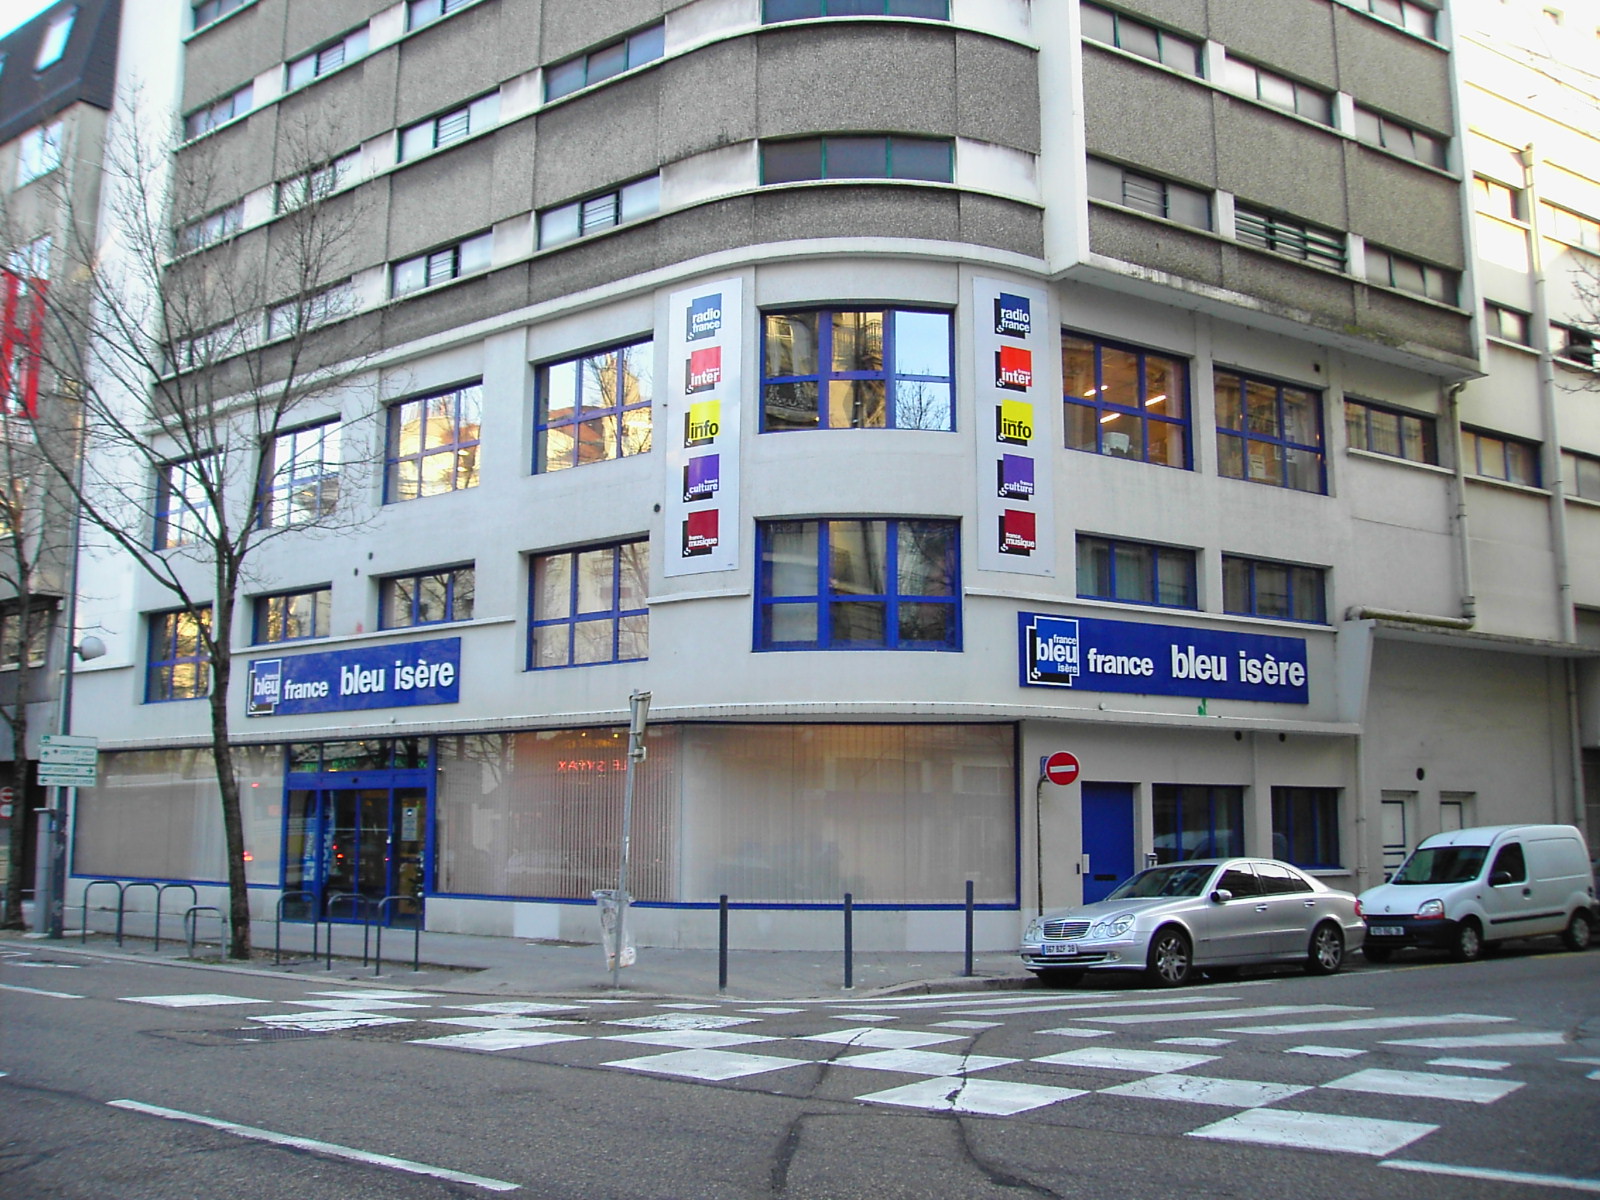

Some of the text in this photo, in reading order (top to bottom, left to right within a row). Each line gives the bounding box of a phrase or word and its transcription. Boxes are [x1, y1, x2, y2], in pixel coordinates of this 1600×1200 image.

[692, 308, 721, 323] radio
[1001, 308, 1030, 323] radio
[692, 320, 721, 333] france
[1001, 318, 1030, 332] france
[690, 371, 720, 387] inter
[1001, 368, 1031, 385] inter
[691, 420, 719, 439] info
[1003, 418, 1032, 438] info
[688, 482, 718, 494] culture
[1004, 482, 1033, 494] culture
[688, 538, 718, 548] musique
[1005, 537, 1035, 549] musique
[1053, 633, 1077, 645] france
[1036, 637, 1077, 663] bleu
[1057, 662, 1077, 673] isère
[1087, 644, 1306, 687] france bleu isère
[254, 677, 279, 695] bleu
[284, 658, 455, 699] france bleu isère
